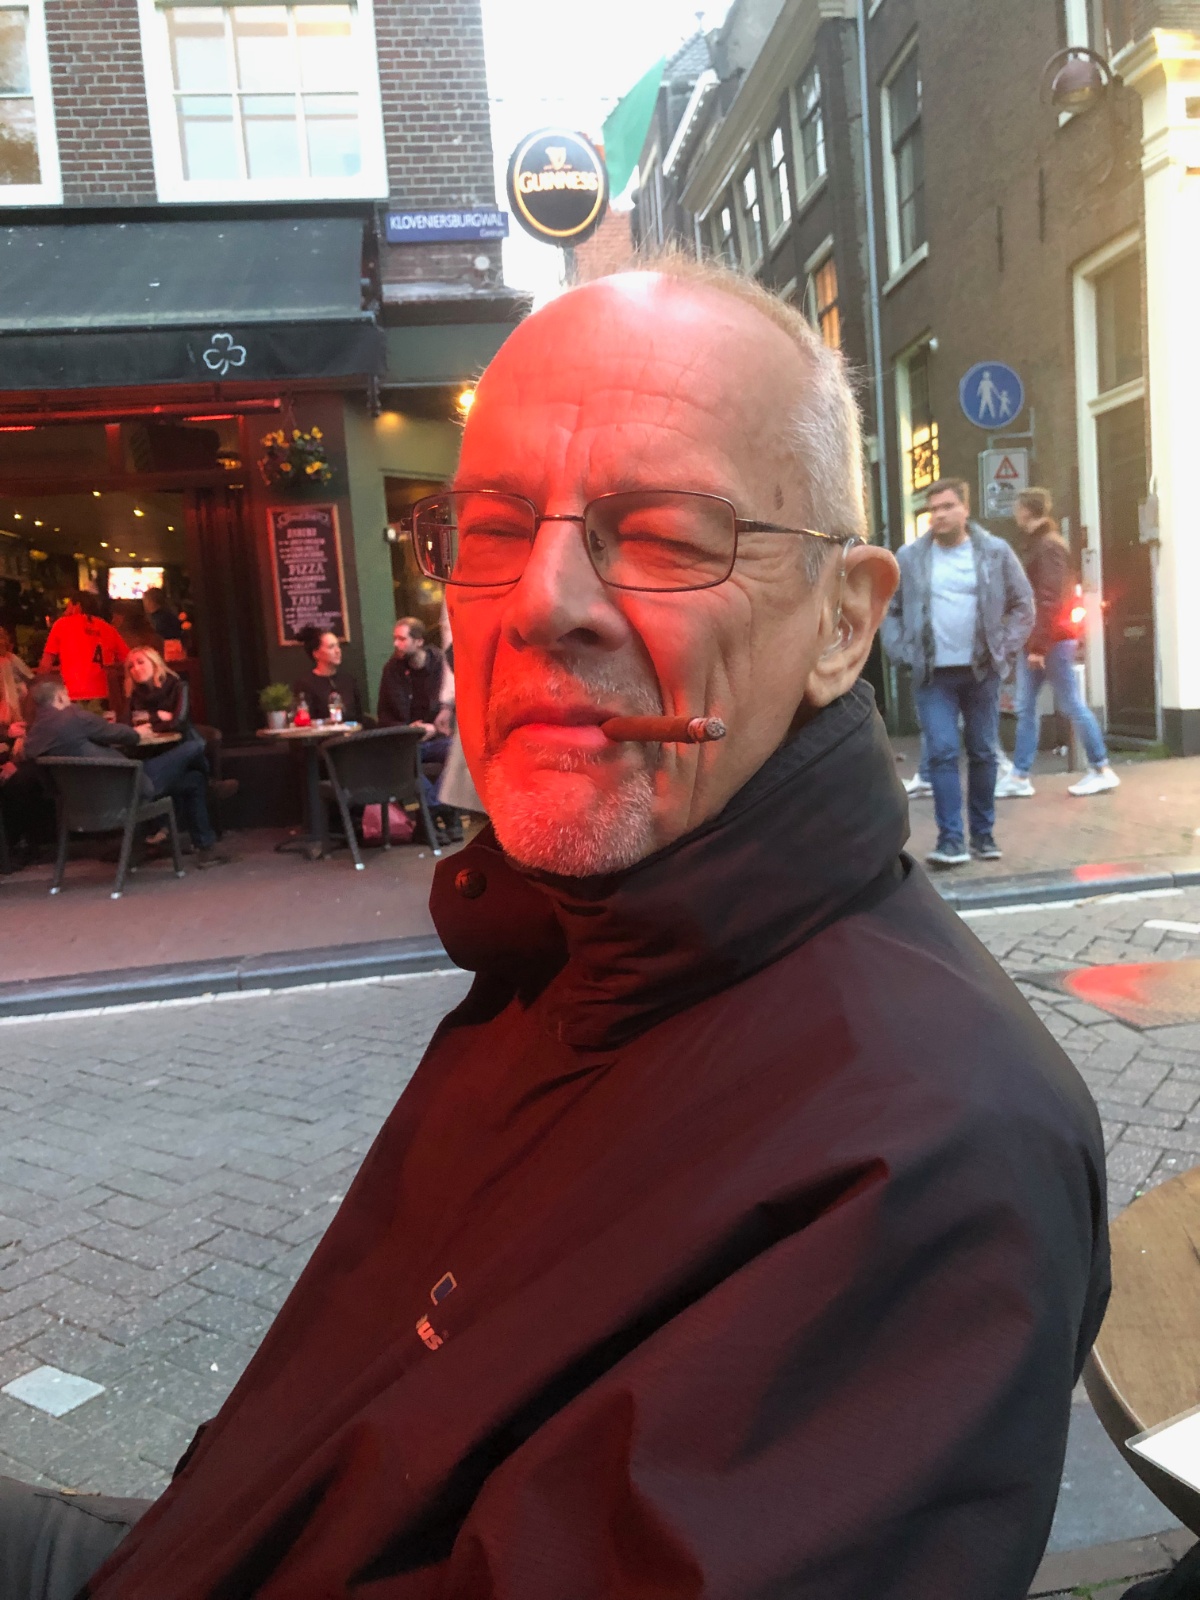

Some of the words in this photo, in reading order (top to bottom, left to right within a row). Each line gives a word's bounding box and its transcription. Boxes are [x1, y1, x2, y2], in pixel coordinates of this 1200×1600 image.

[519, 171, 598, 193] GUINNESS
[389, 213, 504, 230] KLOVENIERSBURGWAL
[288, 563, 325, 576] PIZZA
